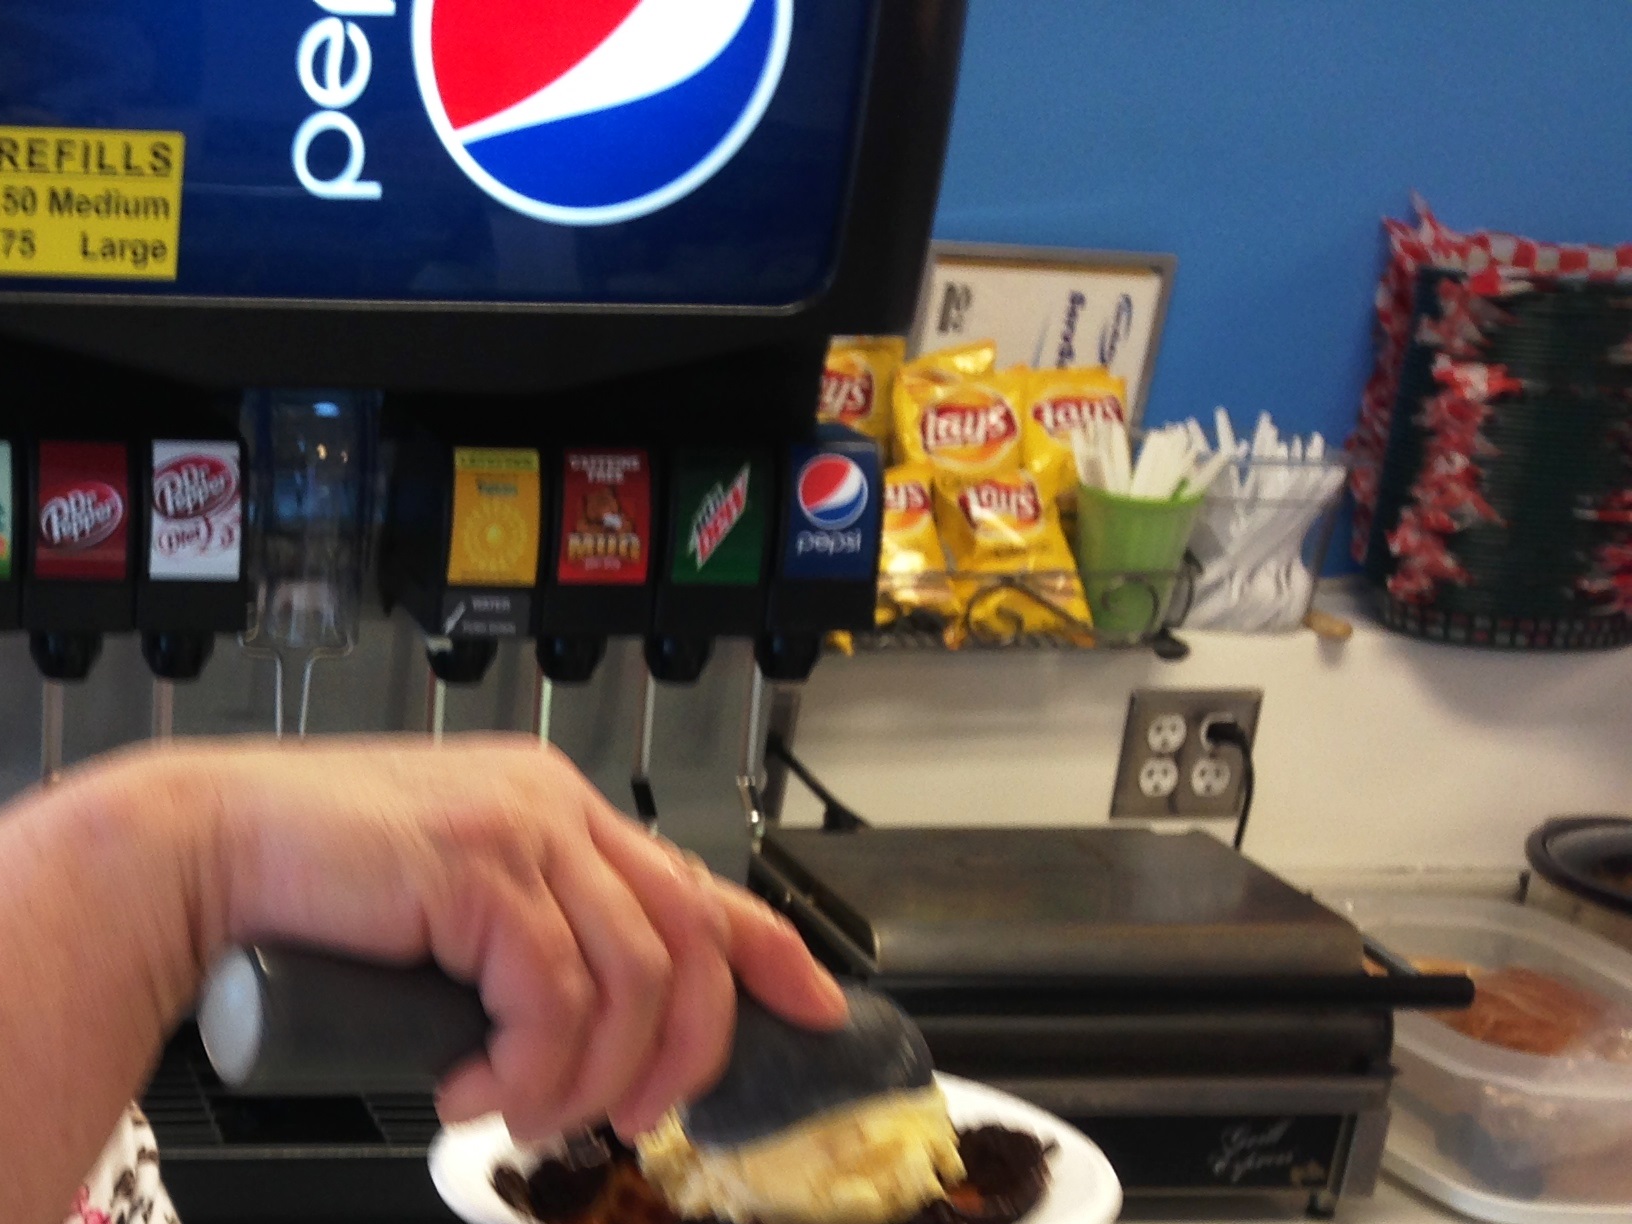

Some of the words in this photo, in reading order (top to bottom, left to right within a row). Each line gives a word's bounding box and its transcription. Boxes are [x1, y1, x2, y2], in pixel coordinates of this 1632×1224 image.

[291, 0, 396, 200] pe
[48, 186, 169, 219] Medium
[80, 231, 167, 269] Large
[797, 528, 862, 556] pepsi
